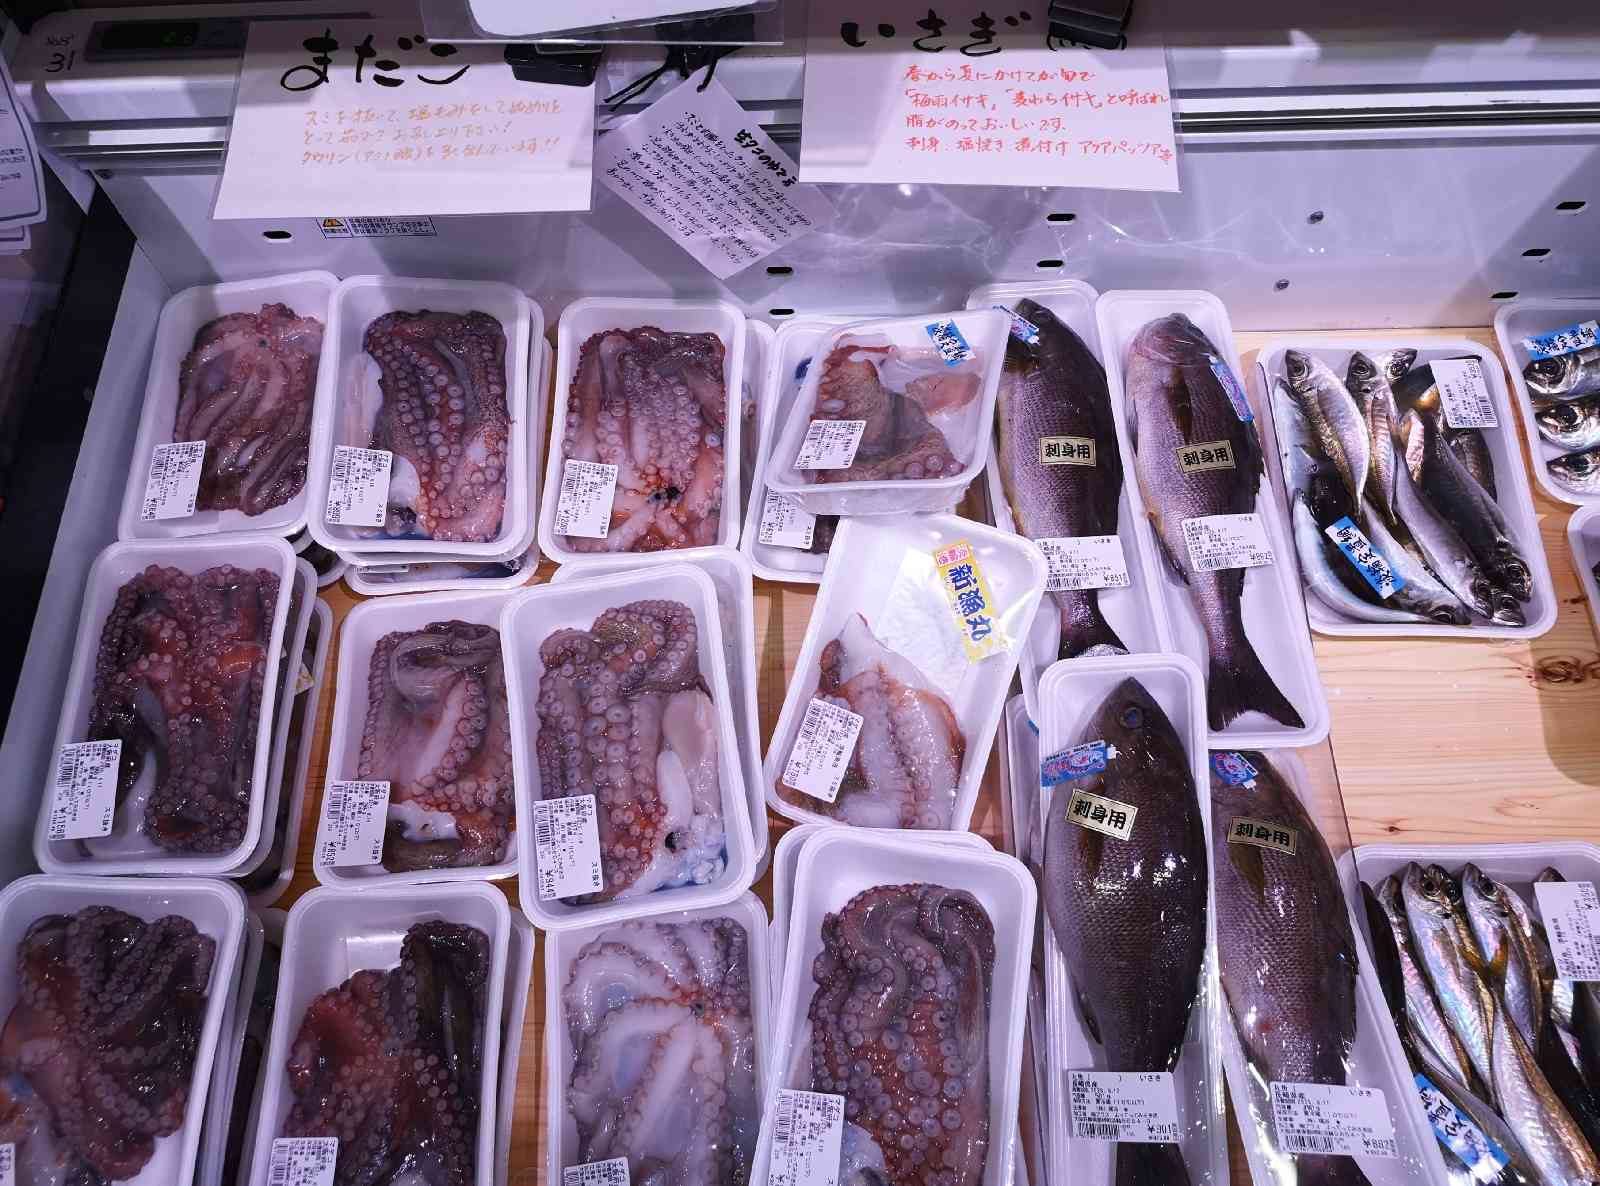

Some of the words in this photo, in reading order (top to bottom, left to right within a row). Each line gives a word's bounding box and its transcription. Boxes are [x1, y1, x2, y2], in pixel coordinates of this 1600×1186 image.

[840, 8, 1031, 57] いさぎ
[45, 50, 75, 72] 31
[1044, 442, 1092, 460] 刺身用
[1183, 448, 1229, 466] 刺身用
[948, 563, 992, 641] 新漁丸
[1073, 799, 1127, 830] 刺身用
[1235, 822, 1290, 845] 刺身用
